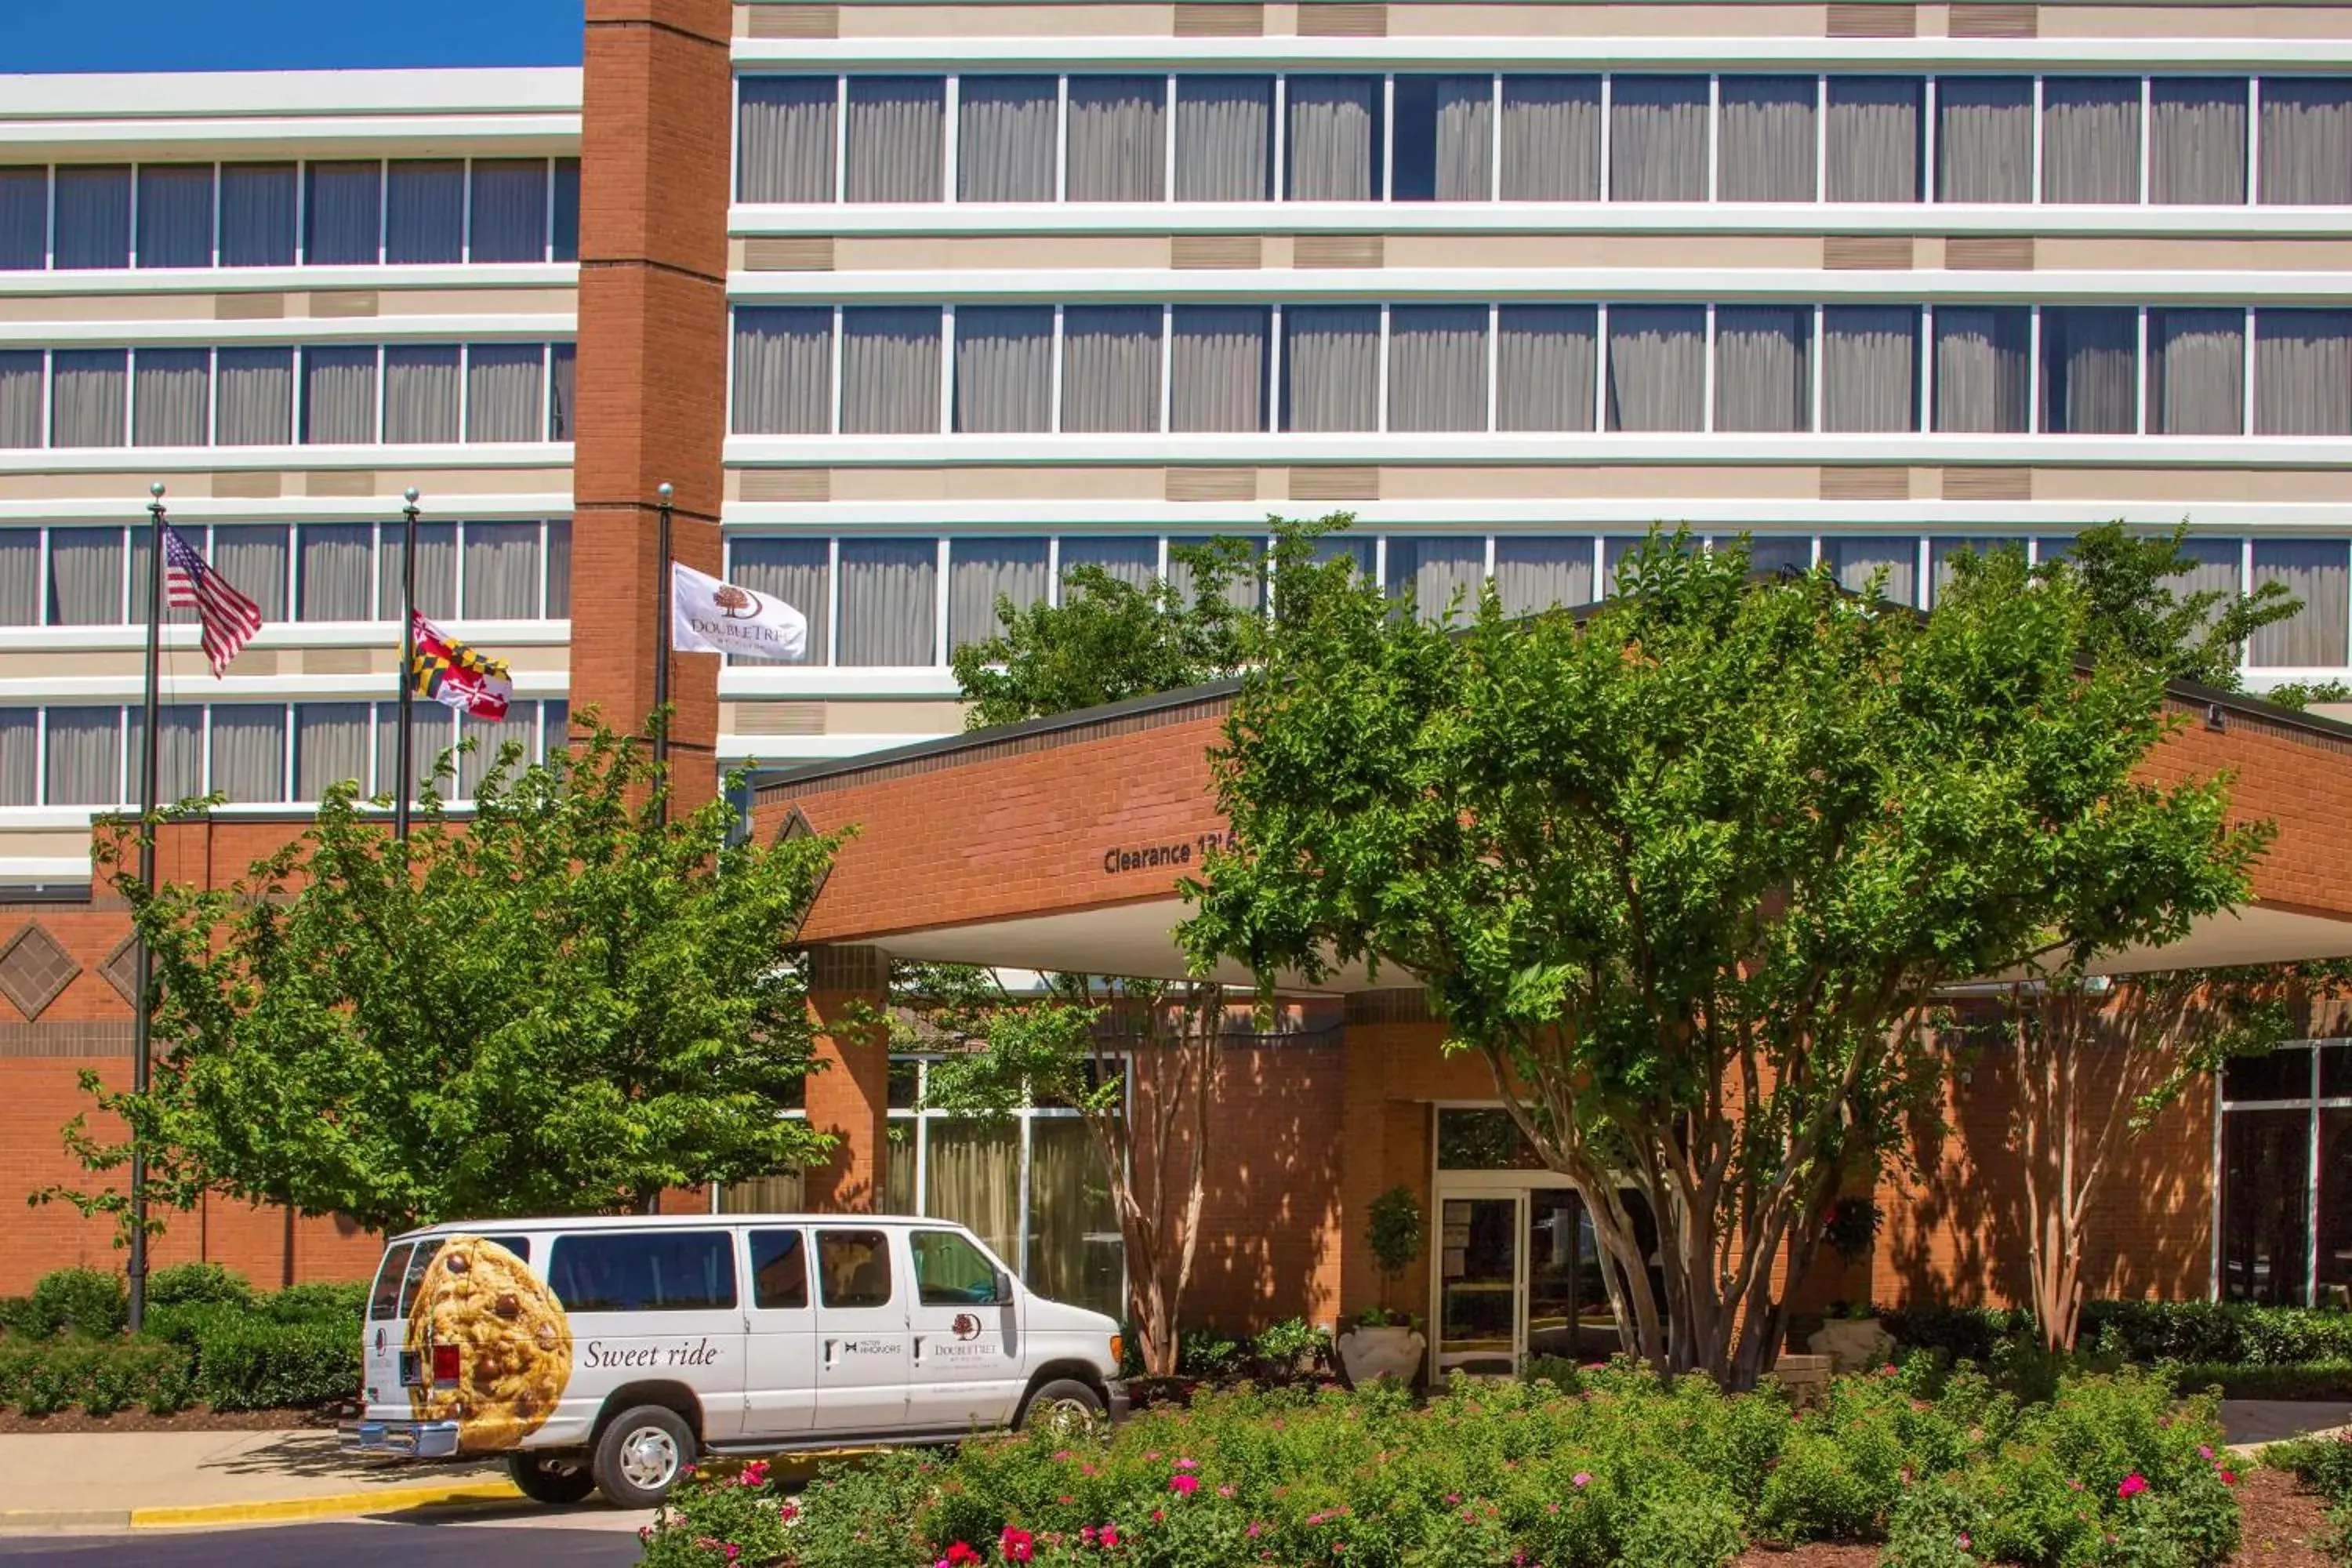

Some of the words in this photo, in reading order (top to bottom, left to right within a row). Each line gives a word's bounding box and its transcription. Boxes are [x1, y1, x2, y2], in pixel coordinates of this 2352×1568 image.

[1104, 843, 1191, 873] Clearance
[584, 1341, 658, 1367] Sweet
[668, 1337, 717, 1366] ride
